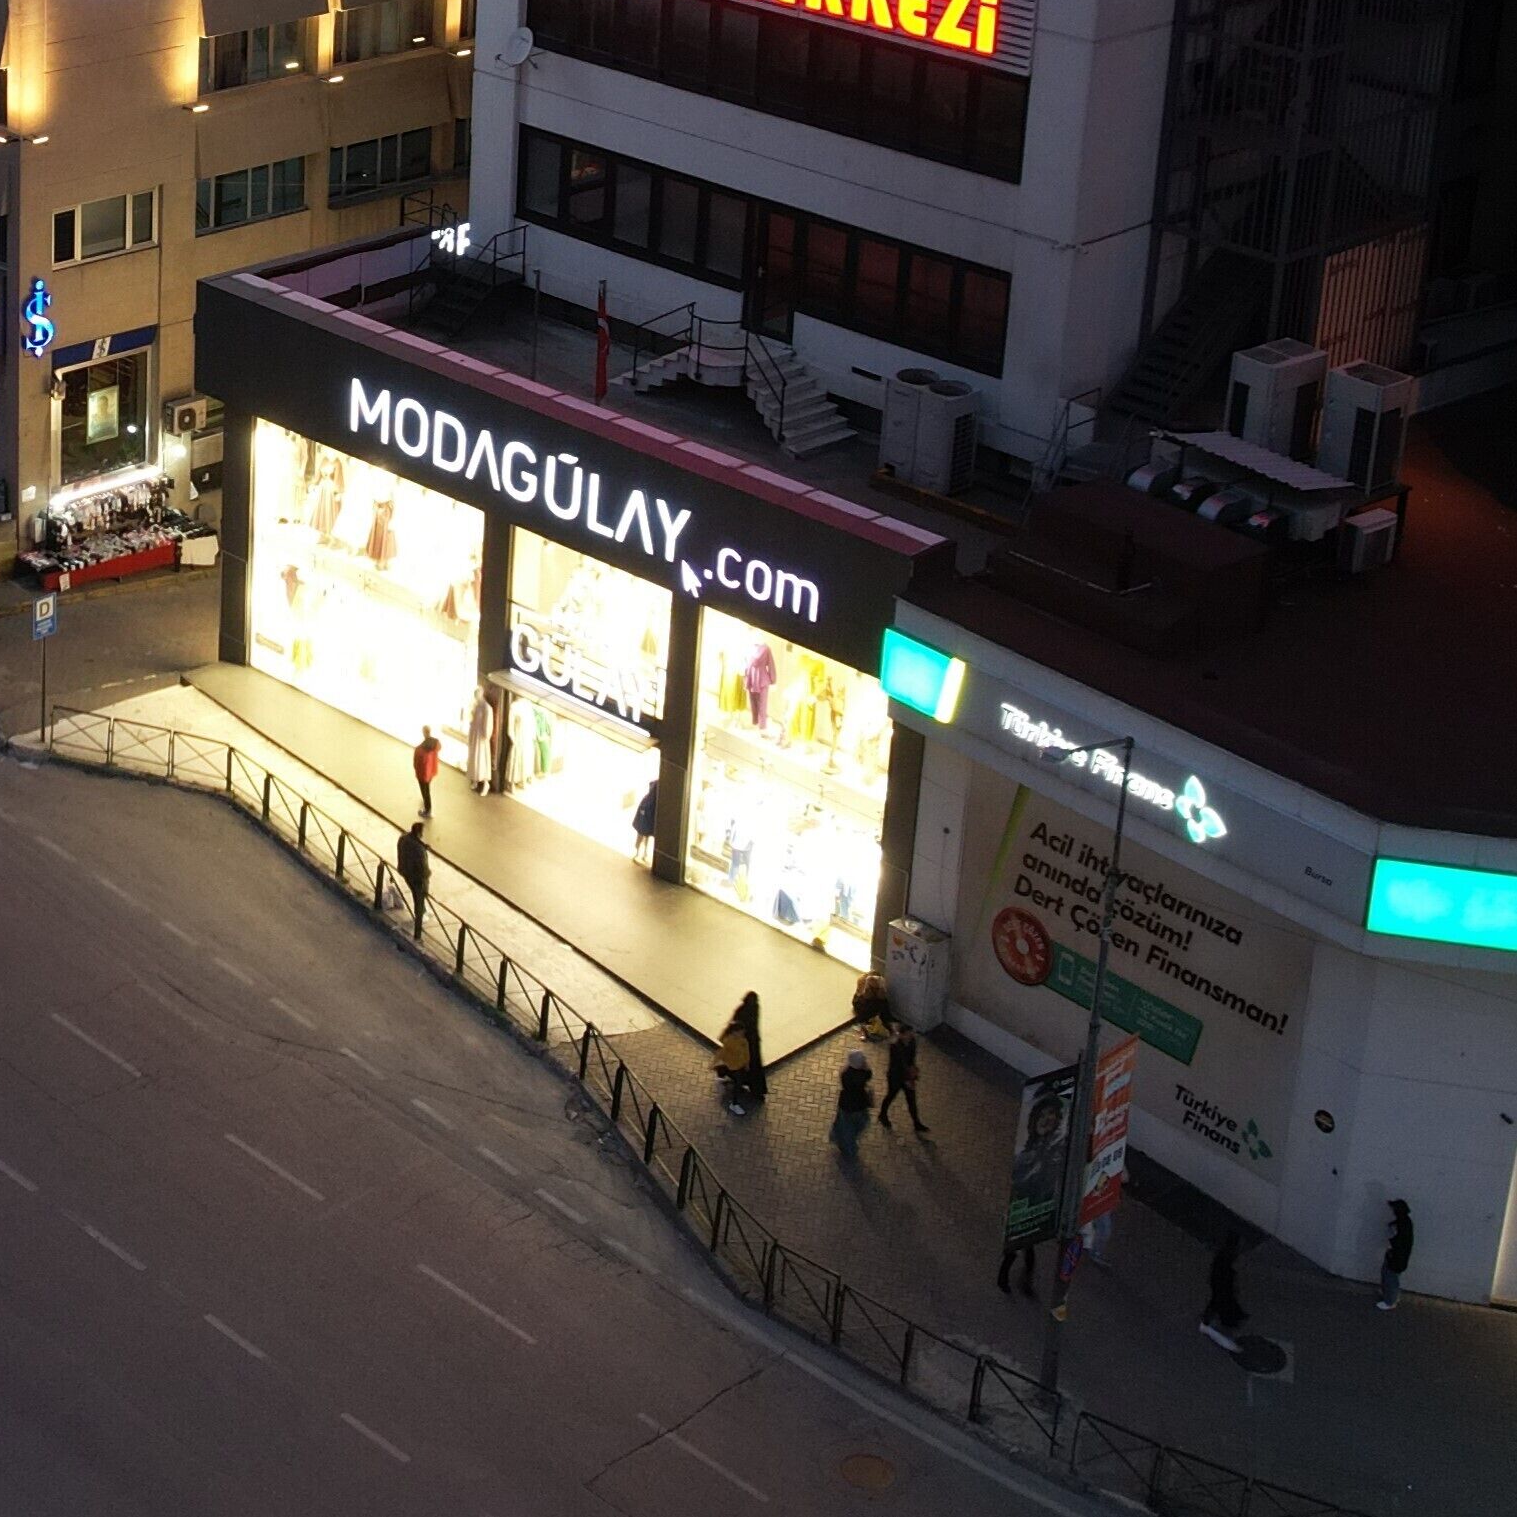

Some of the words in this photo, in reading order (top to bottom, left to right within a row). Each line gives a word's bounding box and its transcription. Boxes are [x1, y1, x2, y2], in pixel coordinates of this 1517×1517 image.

[39, 601, 50, 617] D
[1030, 822, 1074, 858] Acil
[1023, 853, 1102, 904] anında
[1305, 866, 1333, 886] Bursa
[1014, 873, 1064, 916] Dert
[1070, 904, 1140, 957] Çöen
[1146, 944, 1290, 1036] Finansman!
[1175, 1085, 1238, 1133] Türkiye
[1183, 1110, 1241, 1155] Finans
